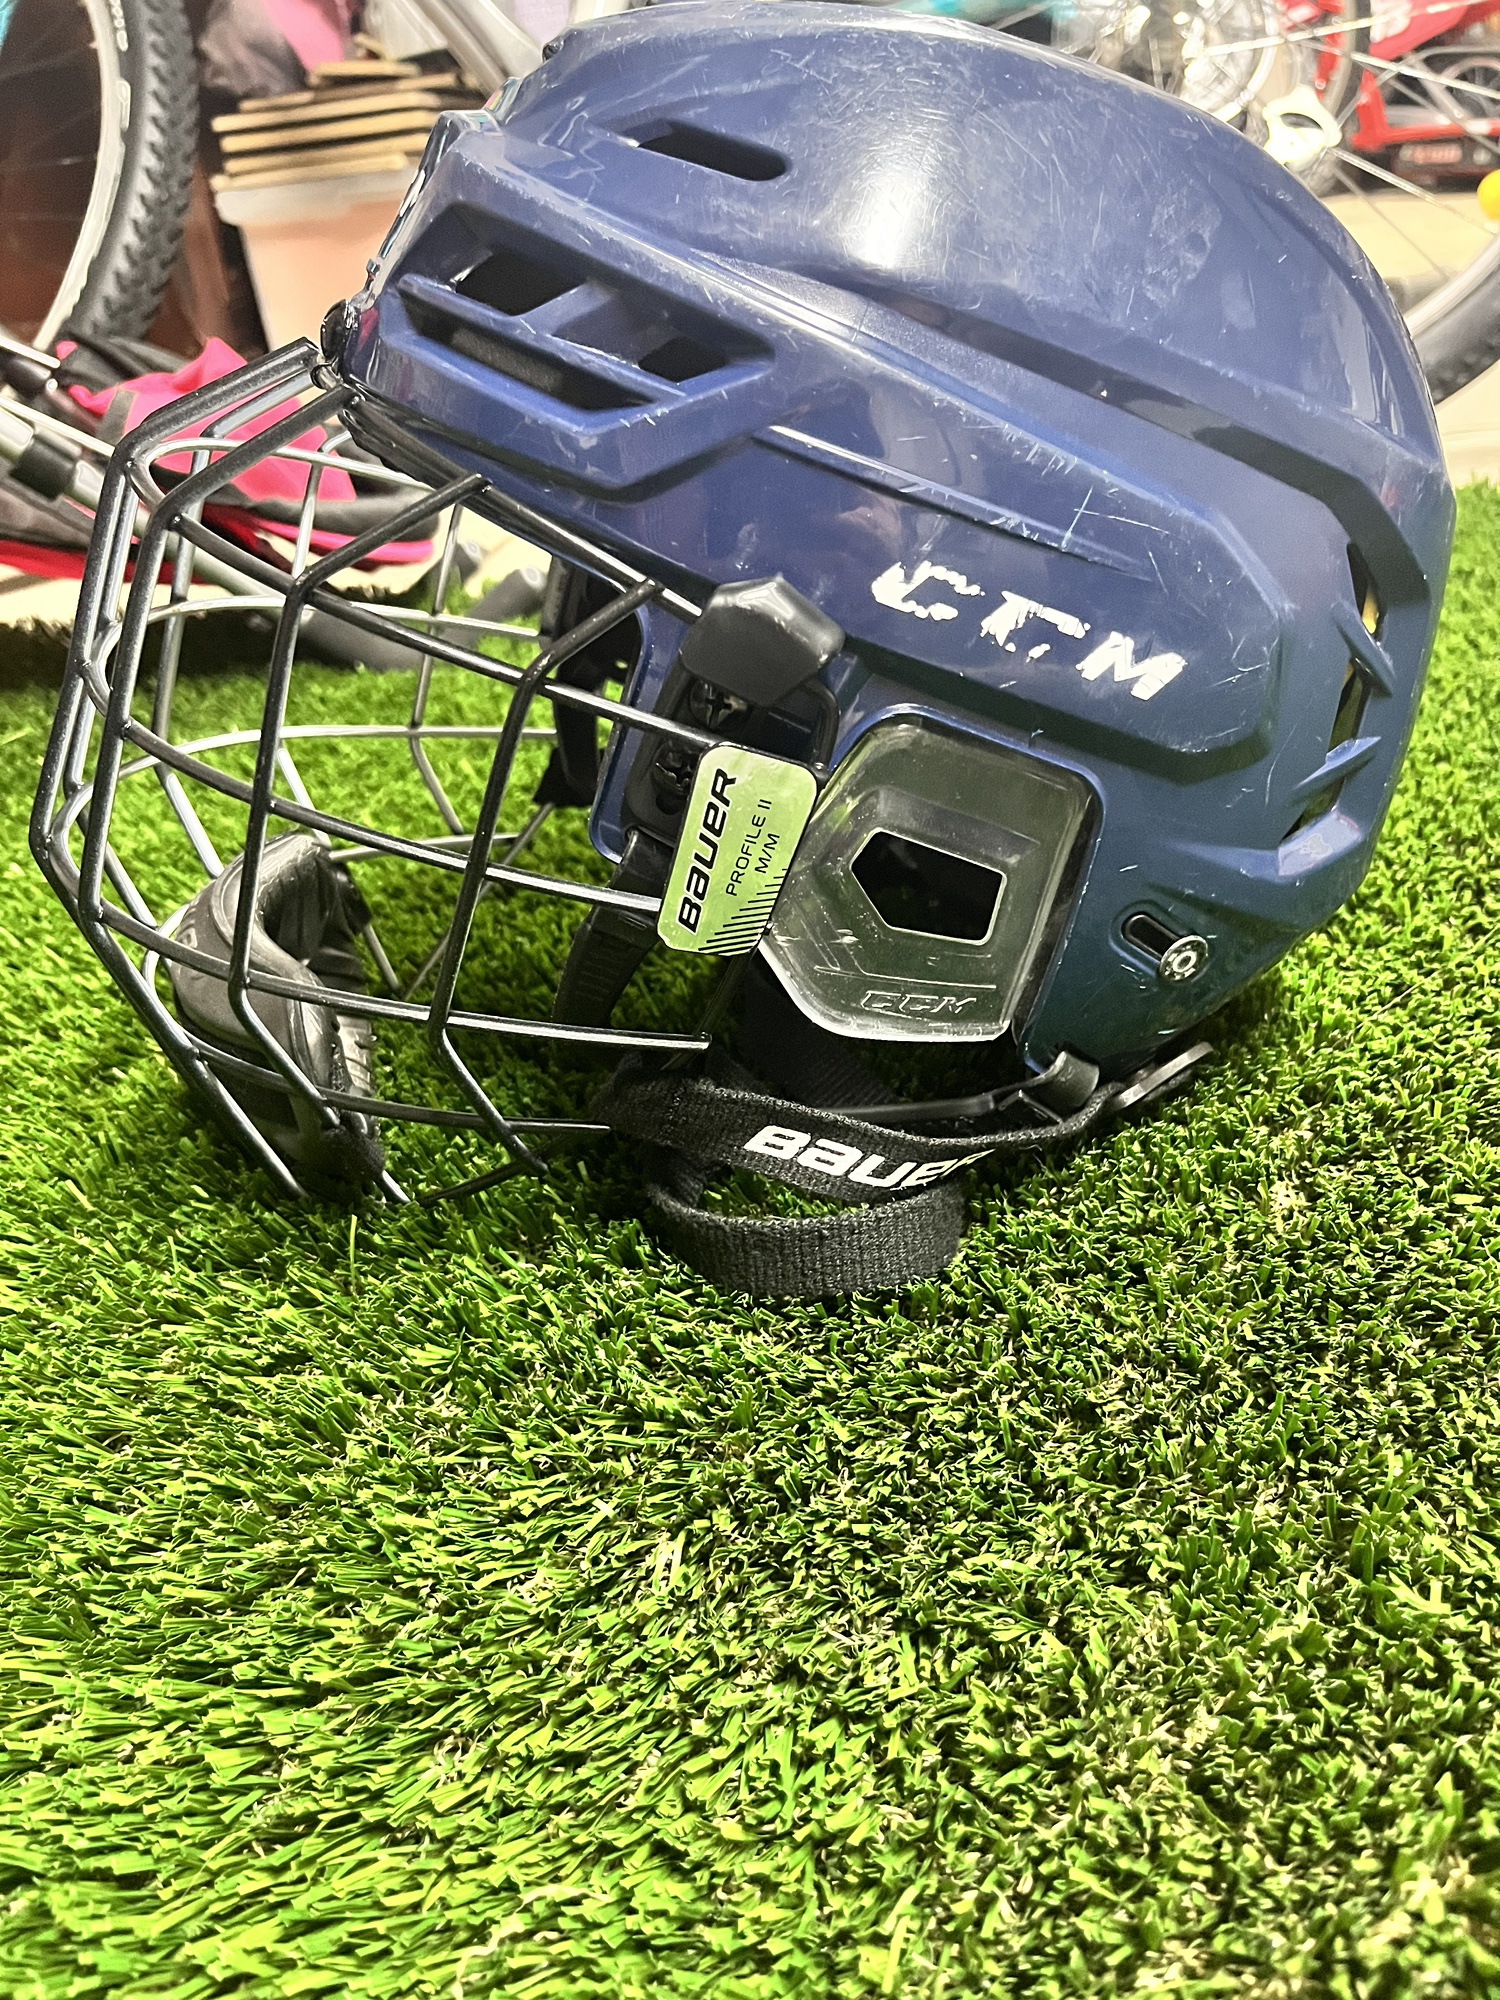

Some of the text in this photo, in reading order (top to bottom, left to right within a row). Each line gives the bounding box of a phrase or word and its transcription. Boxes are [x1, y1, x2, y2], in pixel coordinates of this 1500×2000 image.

[726, 799, 773, 896] PROFILE II
[755, 833, 781, 873] M/M
